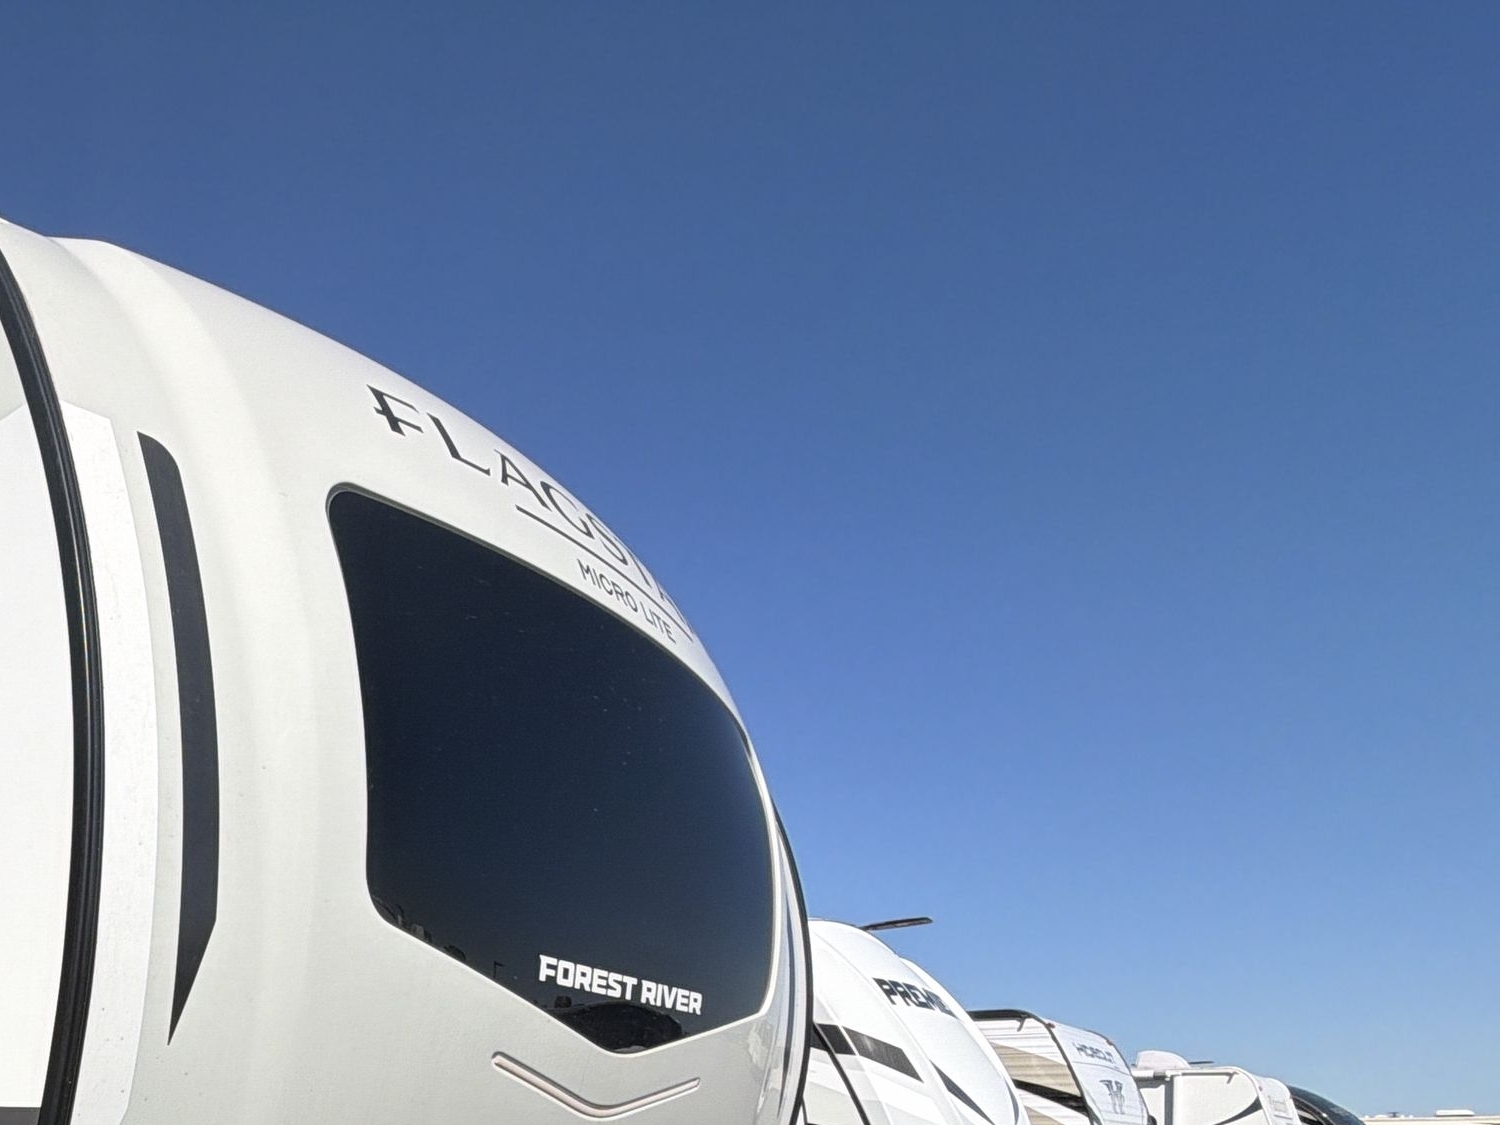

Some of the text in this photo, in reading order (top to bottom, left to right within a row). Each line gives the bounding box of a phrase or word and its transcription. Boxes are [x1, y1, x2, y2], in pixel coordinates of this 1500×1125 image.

[365, 383, 687, 627] FLAGST
[576, 558, 677, 644] MICRO LITE
[538, 954, 703, 1016] FOREST RIVER
